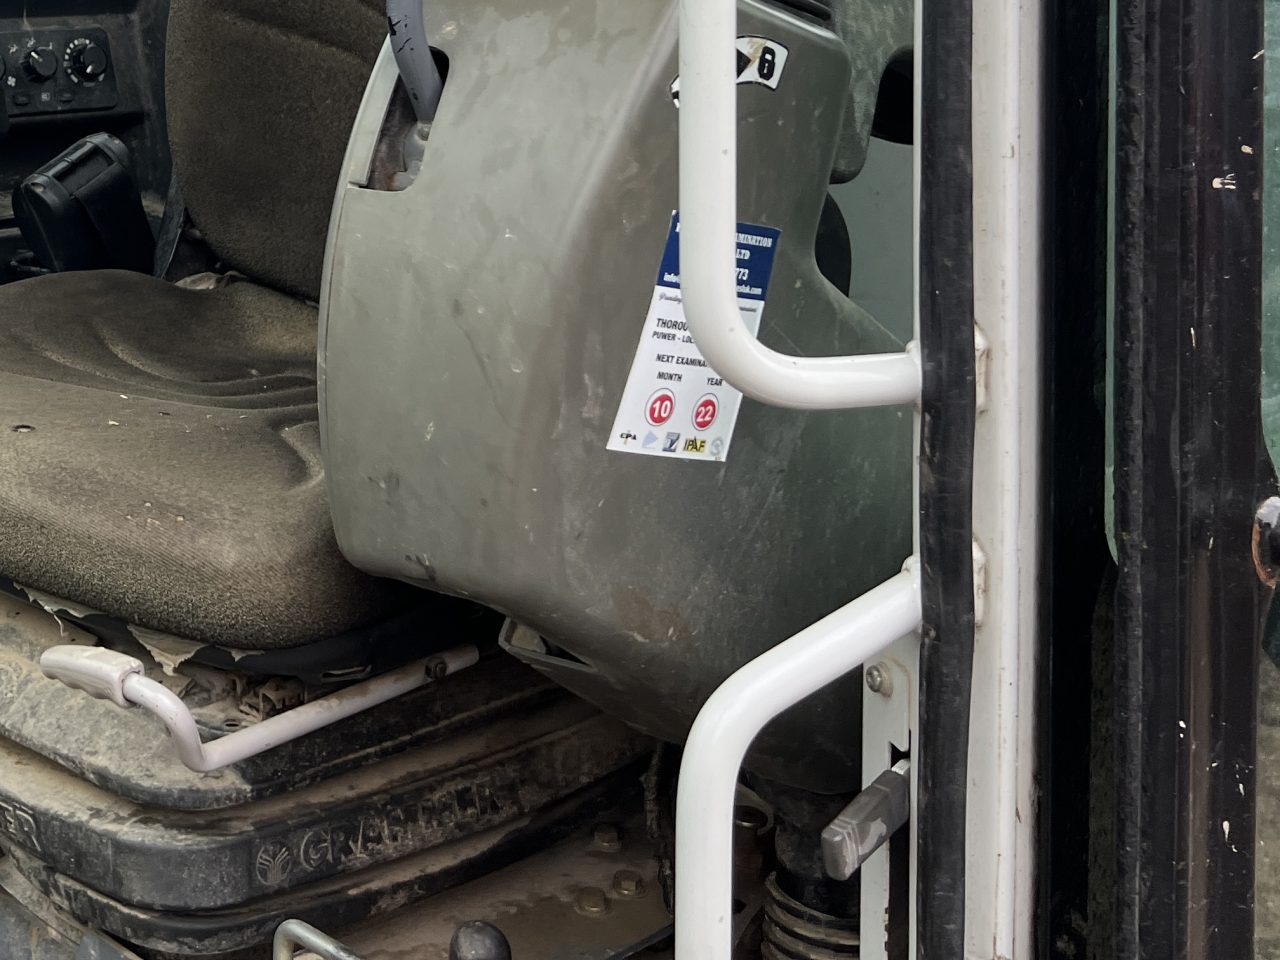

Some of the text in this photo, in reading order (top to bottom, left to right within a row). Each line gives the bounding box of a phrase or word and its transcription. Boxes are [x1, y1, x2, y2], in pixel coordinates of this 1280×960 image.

[656, 318, 688, 331] THOROU
[656, 353, 708, 367] NEXT EXAMINA
[656, 371, 683, 382] MONTH
[707, 377, 724, 386] YEAR
[652, 401, 671, 418] 10
[696, 406, 713, 422] 22
